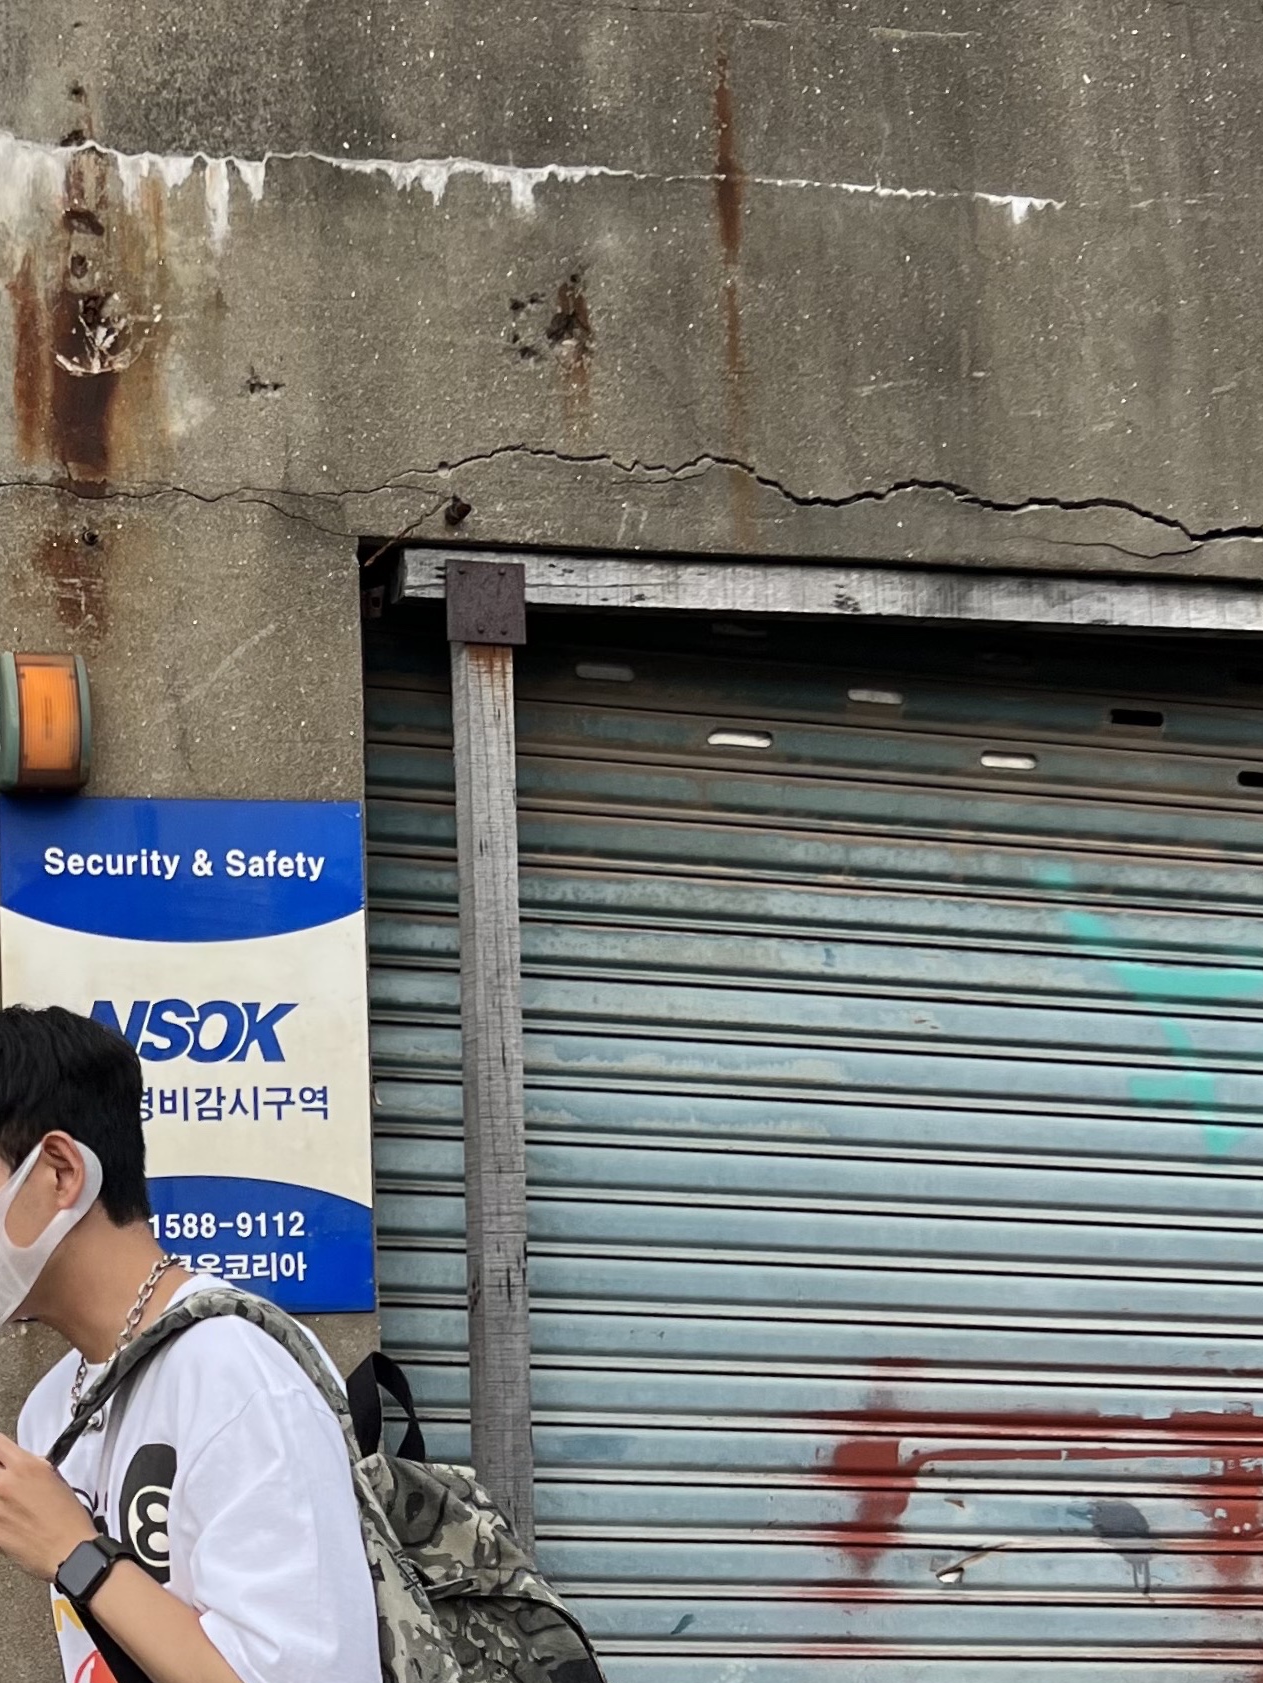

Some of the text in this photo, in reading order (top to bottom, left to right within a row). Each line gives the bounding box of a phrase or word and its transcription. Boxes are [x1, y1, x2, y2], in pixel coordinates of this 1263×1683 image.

[44, 846, 326, 882] Security & Safety
[148, 1211, 306, 1239] 1588-9112
